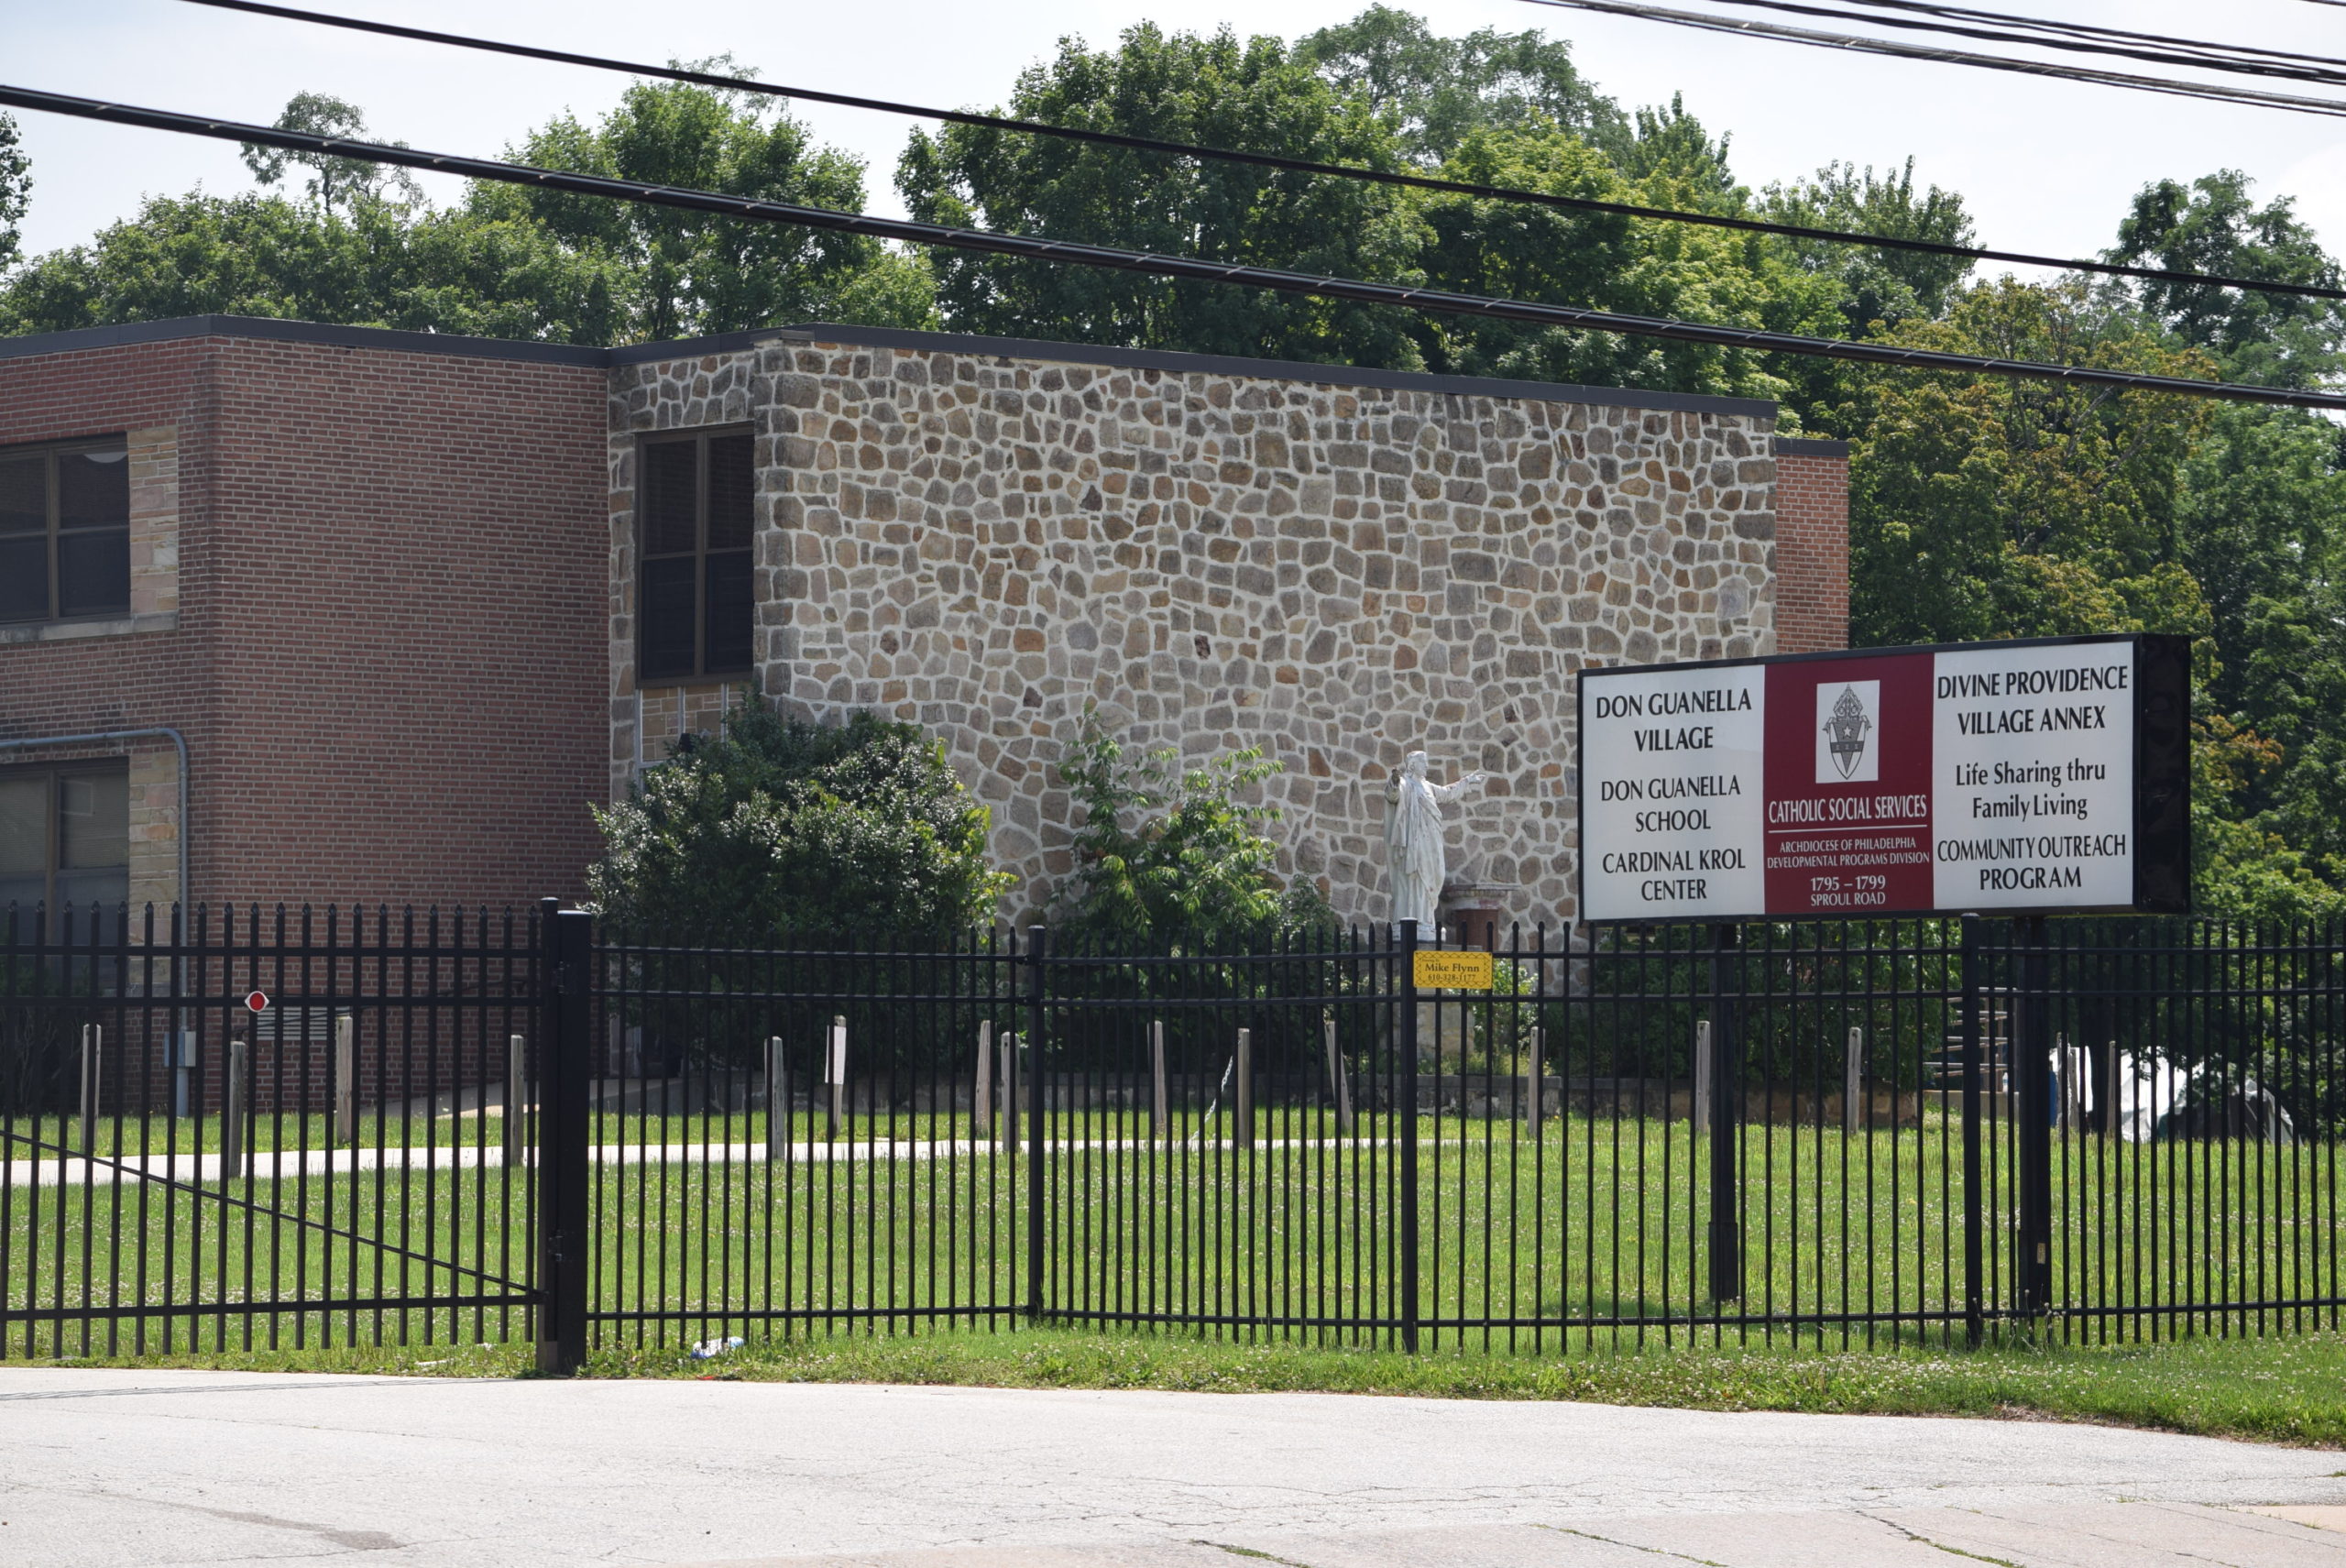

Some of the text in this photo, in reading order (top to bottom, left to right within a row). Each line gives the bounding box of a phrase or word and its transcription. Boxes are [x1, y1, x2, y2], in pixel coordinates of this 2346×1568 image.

[1937, 665, 2128, 699] DIVINE PROVIDENCE
[1596, 687, 1752, 718] DON GUANELLA
[1957, 705, 2106, 735] VILLAGE ANNEX
[1634, 726, 1714, 752] VILLAGE
[1956, 758, 2106, 787] Life Sharing thru
[1601, 774, 1741, 801] DON GUANELLA
[1769, 794, 1927, 823] CATHOLIC SOCIAL SERVICES
[1973, 792, 2088, 822] Family Living
[1635, 809, 1711, 832] SCHOOL
[1780, 837, 1916, 853] ARCHDIOCESE OF PHILADELPHIA
[1937, 834, 2126, 861] COMMUNITY OUTREACH
[1602, 848, 1746, 873] CARDINAL KROL
[1767, 851, 1930, 869] DEVELOPMENTAL PROGRAMS DIVISION
[1641, 879, 1707, 901] CENTER
[1810, 876, 1839, 892] 1795
[1855, 875, 1886, 890] 1799
[1979, 866, 2082, 890] PROGRAM
[1810, 891, 1886, 906] SPROUL ROAD
[1425, 962, 1480, 974] Mike Flynn
